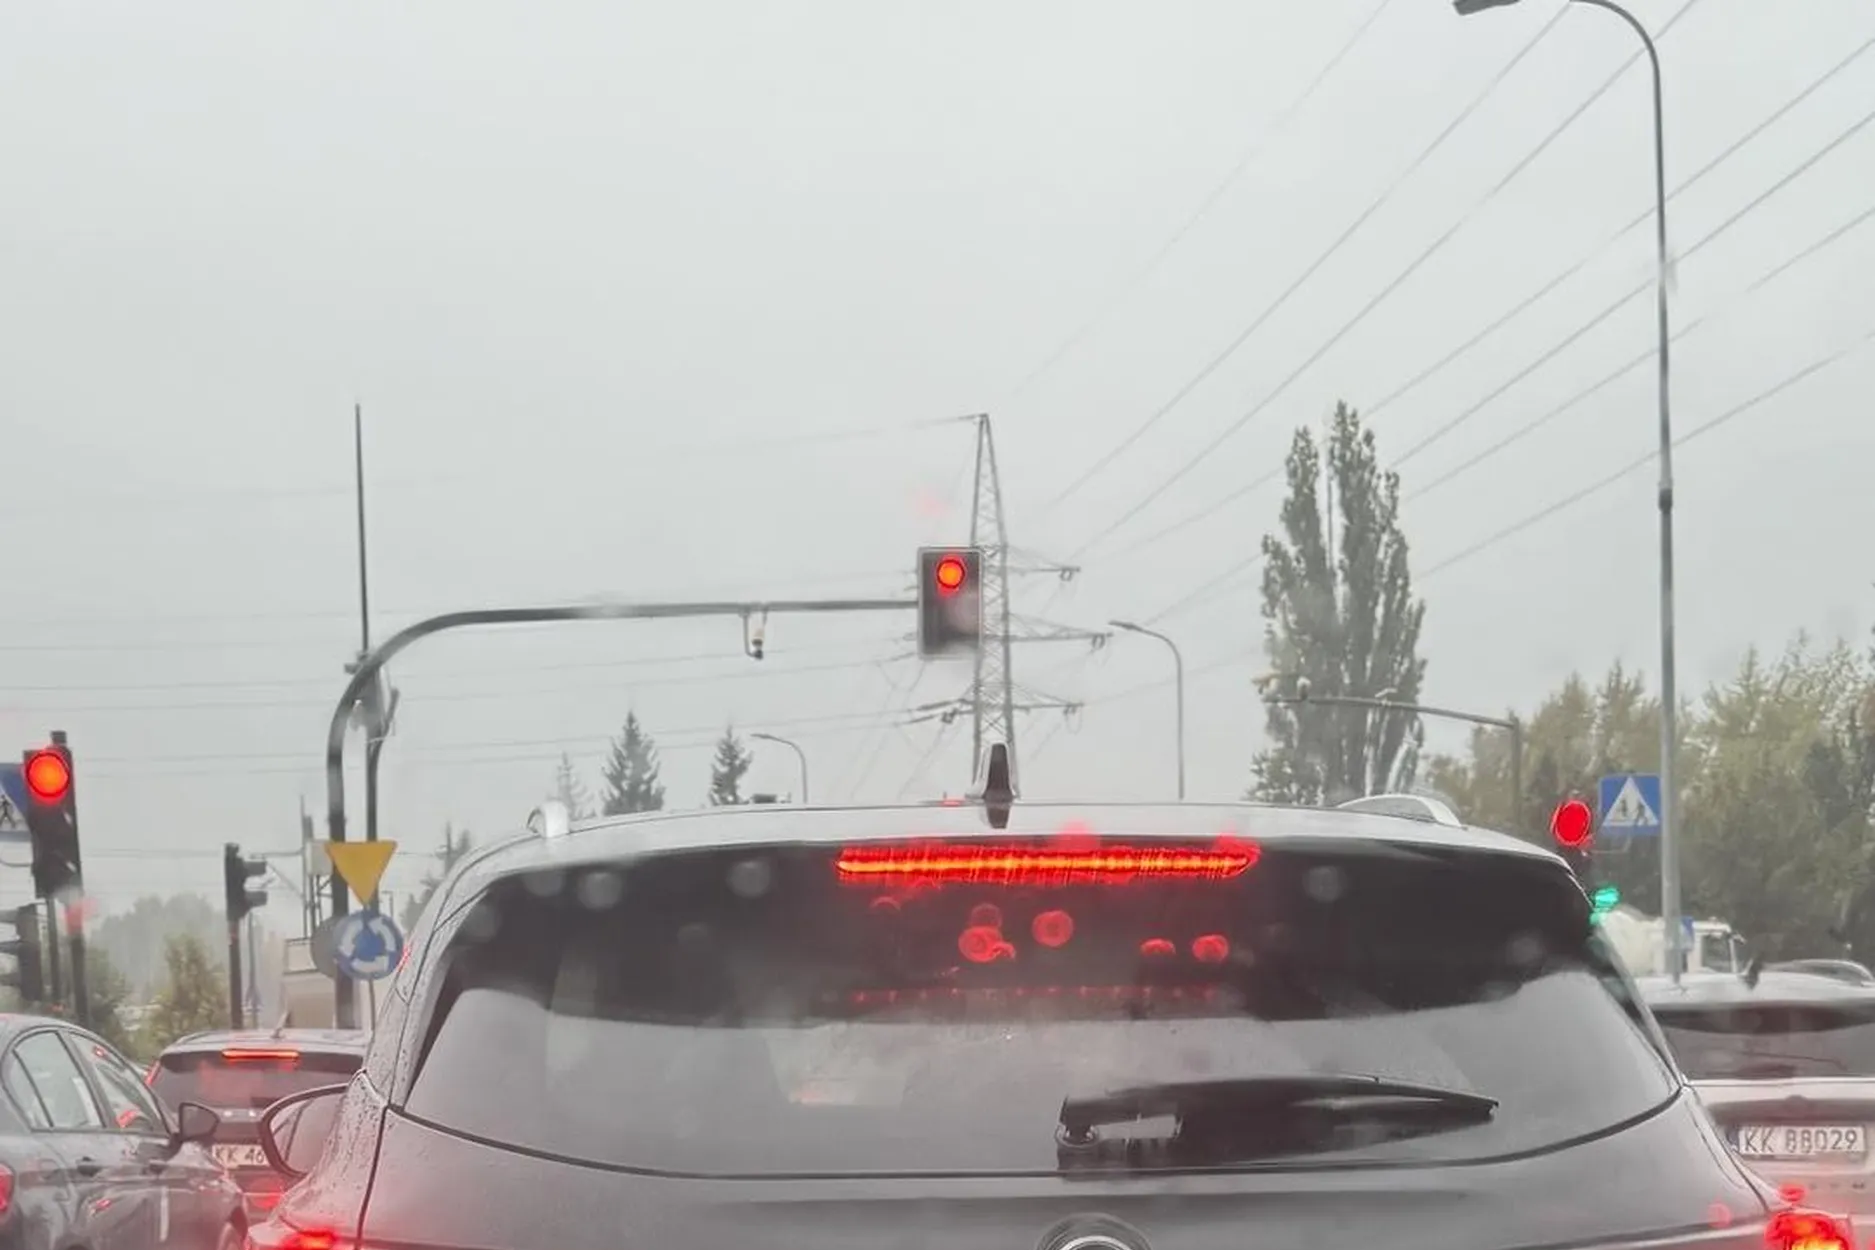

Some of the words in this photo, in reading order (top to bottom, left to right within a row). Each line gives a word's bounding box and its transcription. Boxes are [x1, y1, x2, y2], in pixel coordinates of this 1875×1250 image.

[1744, 1126, 1774, 1152] KK
[1785, 1129, 1857, 1153] 88029
[244, 1147, 265, 1164] 46
